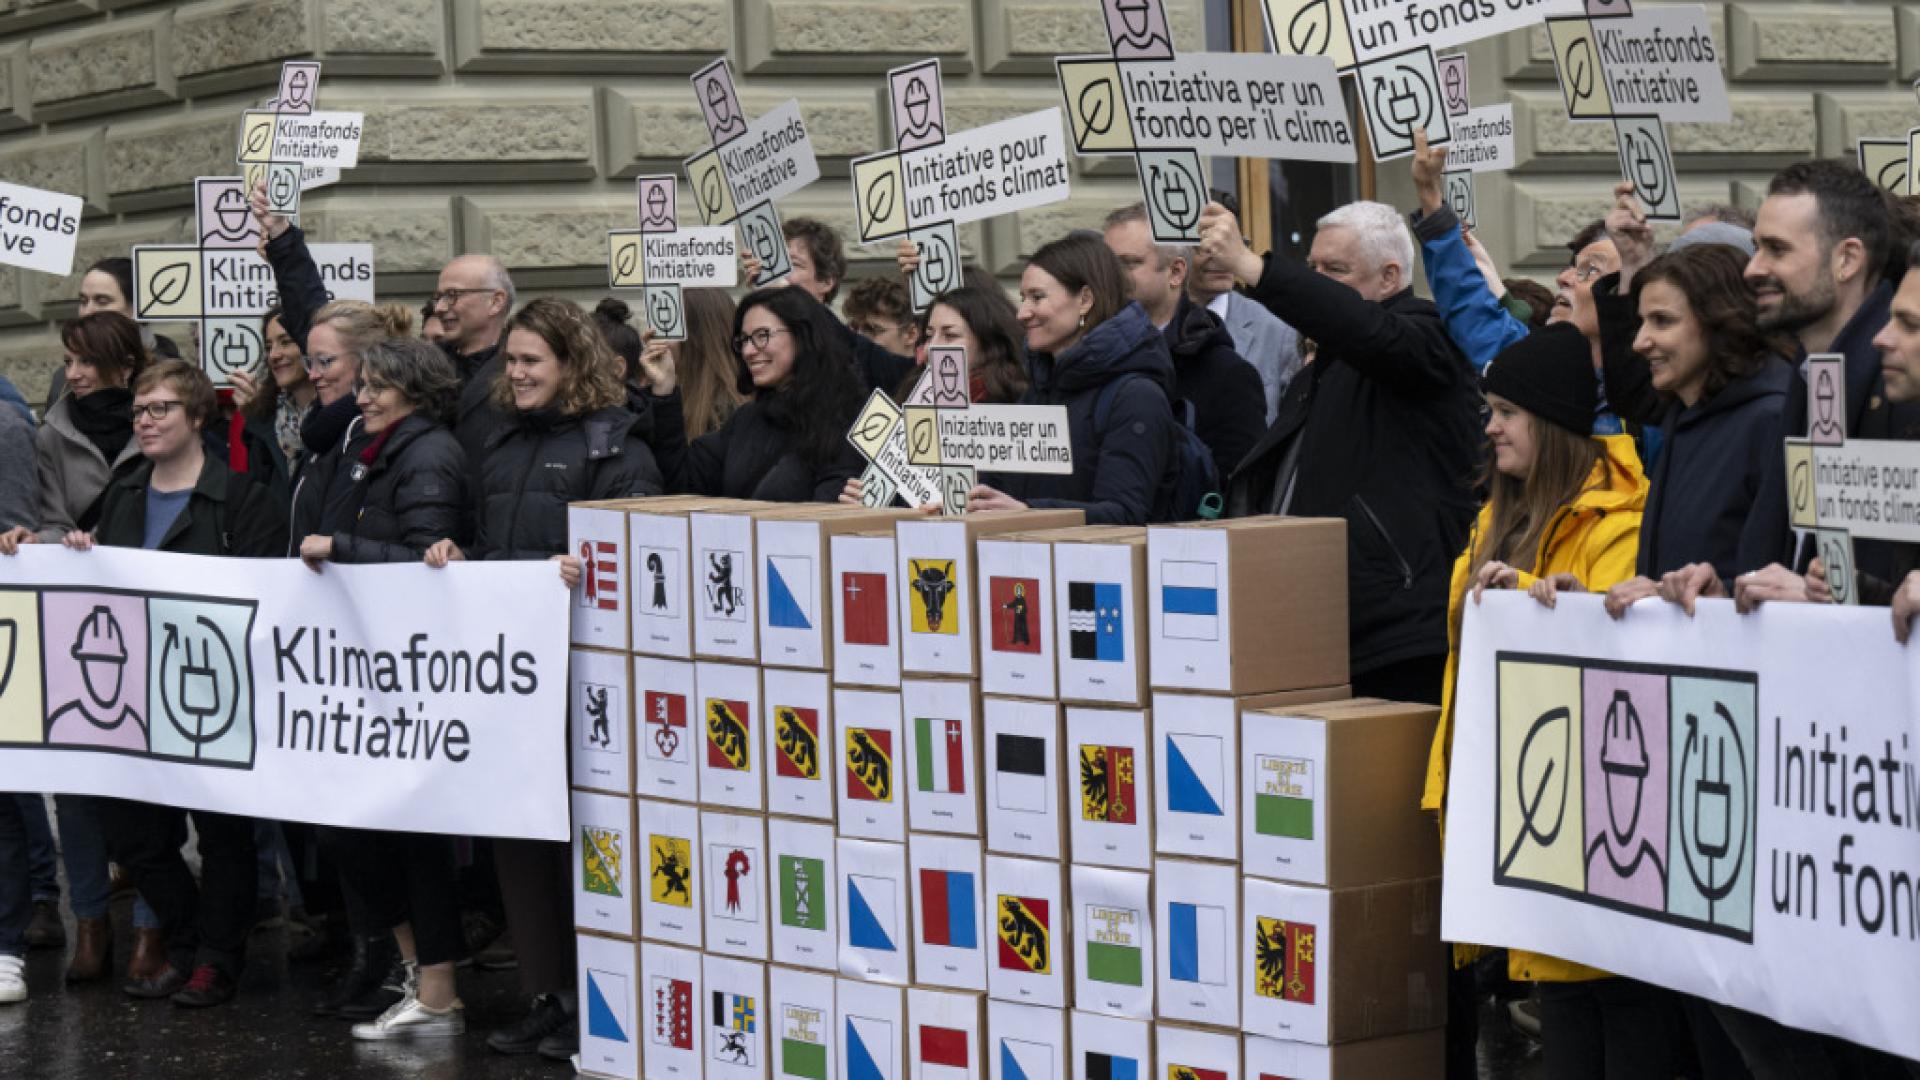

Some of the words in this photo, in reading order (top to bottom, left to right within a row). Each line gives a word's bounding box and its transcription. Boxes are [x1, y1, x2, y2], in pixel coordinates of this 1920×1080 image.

[1358, 20, 1397, 50] un
[1404, 0, 1495, 37] fonds
[1597, 25, 1715, 65] Klimafonds
[1126, 71, 1242, 106] Iniziativa
[1246, 82, 1286, 111] per
[1293, 83, 1325, 106] un
[1607, 67, 1700, 104] Initiative
[277, 119, 361, 140] Klimafonds
[1135, 106, 1213, 139] fondo
[1219, 118, 1258, 146] per
[1262, 111, 1281, 142] il
[1285, 113, 1351, 146] clima
[1452, 114, 1512, 143] limafonds
[274, 139, 339, 159] Initiative
[723, 116, 805, 179] Klimafonds
[905, 145, 994, 189] Initiative
[1000, 134, 1047, 172] pour
[1446, 141, 1498, 166] nitiative
[732, 158, 797, 206] Initiative
[910, 194, 935, 218] un
[938, 174, 997, 211] fonds
[1002, 158, 1067, 198] climat
[0, 229, 35, 255] ve
[646, 236, 734, 258] Klimafonds
[209, 256, 371, 284] Klimnds
[646, 259, 715, 279] Initiative
[940, 415, 1005, 438] Iniziativa
[1010, 420, 1034, 441] per
[1038, 420, 1057, 439] un
[942, 436, 984, 460] fondo
[989, 443, 1011, 463] per
[1015, 437, 1027, 456] il
[1030, 439, 1070, 463] clima
[1815, 455, 1878, 489] Initiative
[1883, 464, 1920, 495] pour
[1819, 496, 1835, 518] un
[1839, 488, 1880, 522] fonds
[273, 625, 538, 694] Klimafonds
[276, 690, 471, 763] Initiative
[1771, 848, 1818, 921] un
[1832, 833, 1920, 942] fon
